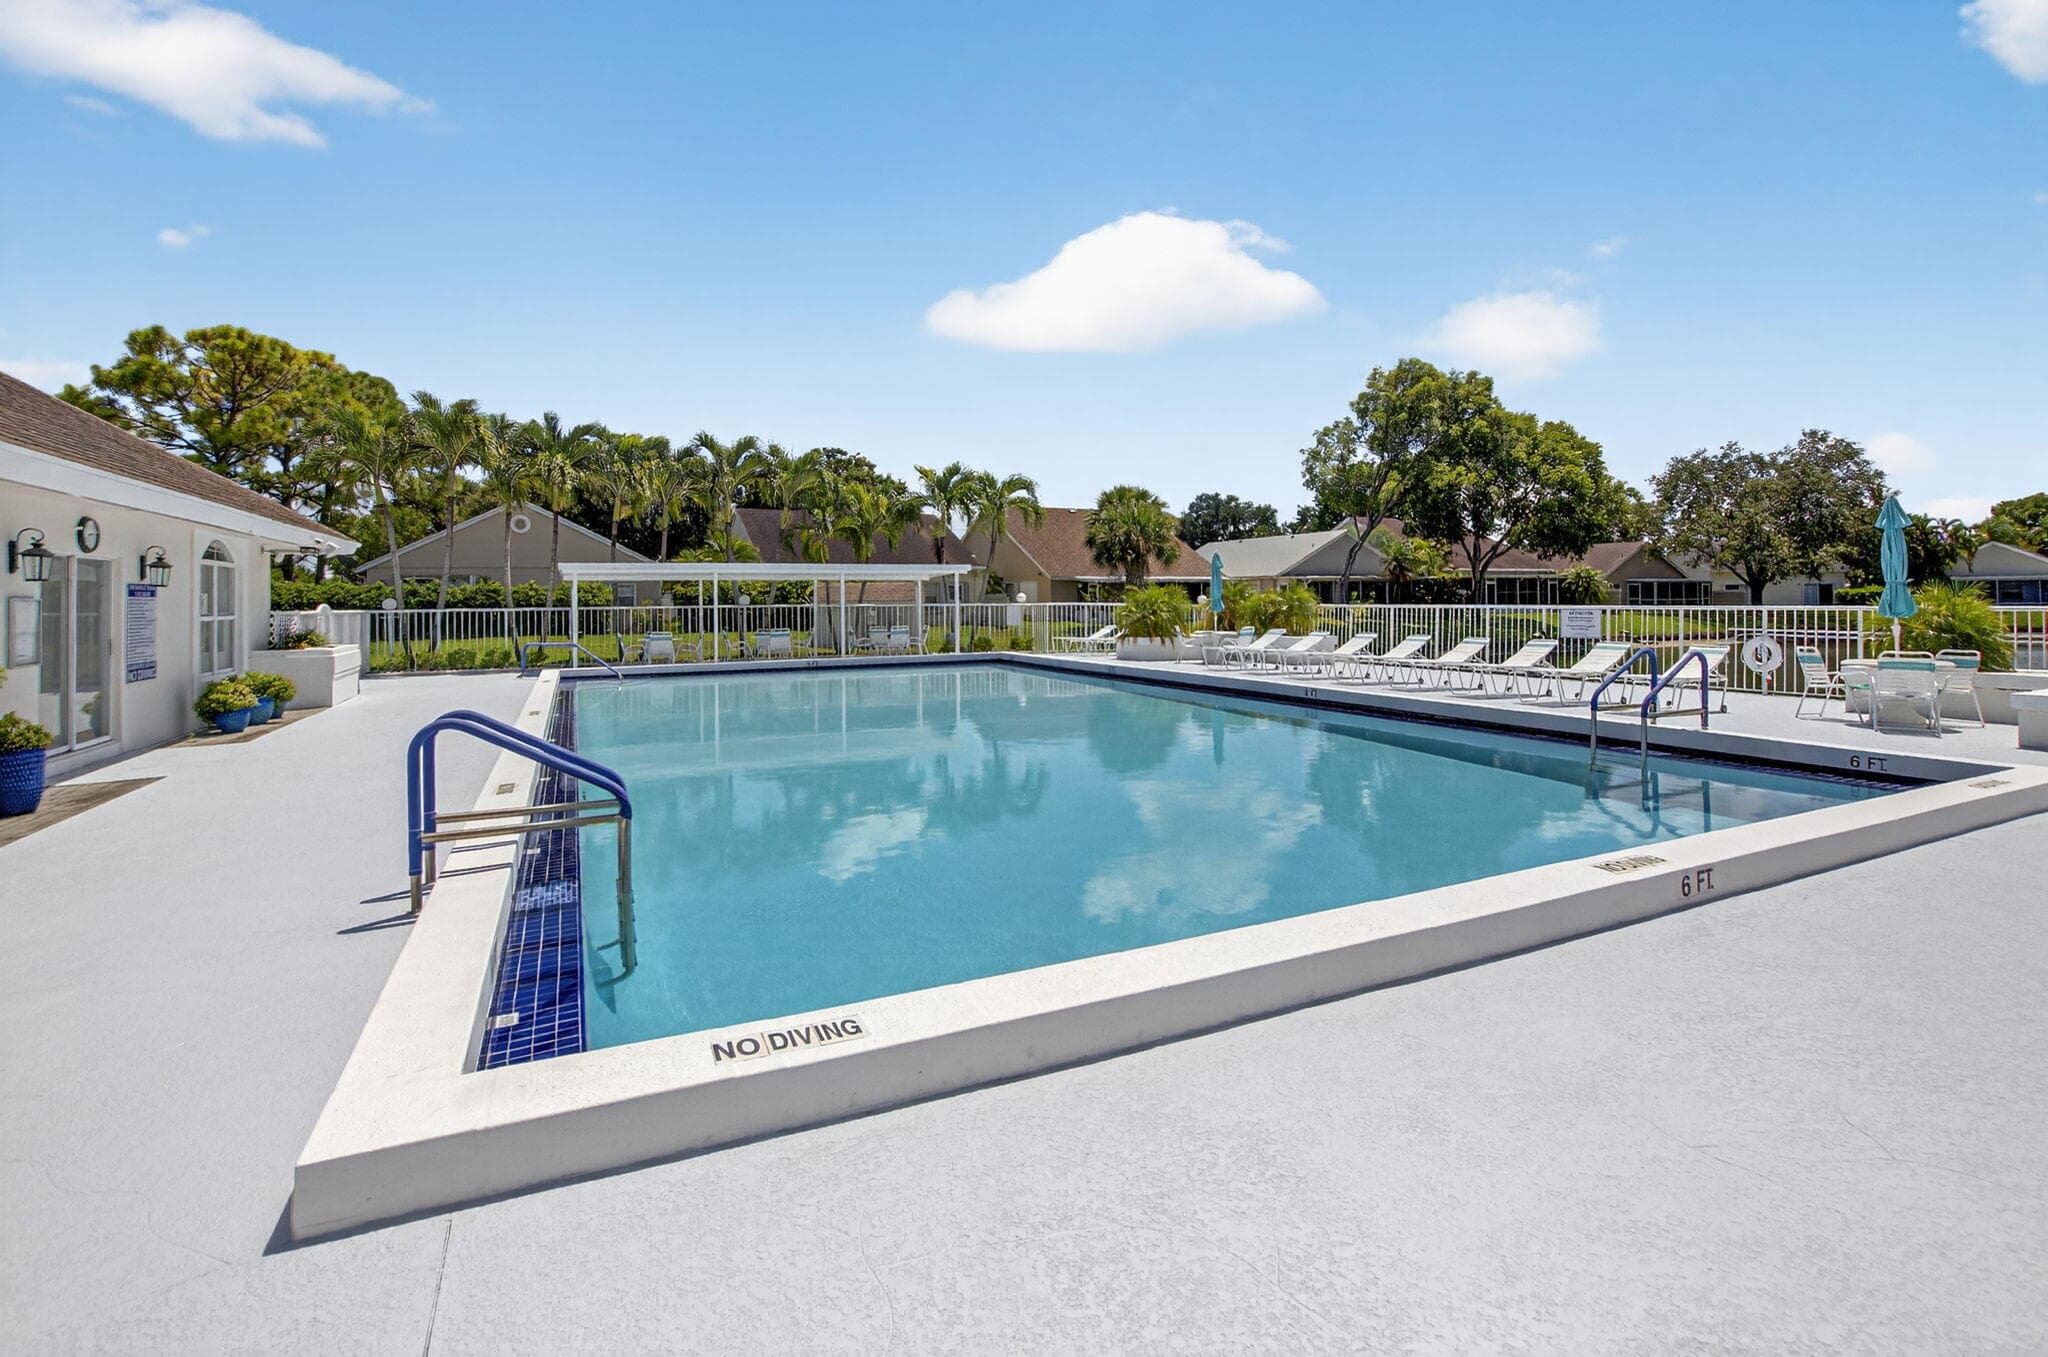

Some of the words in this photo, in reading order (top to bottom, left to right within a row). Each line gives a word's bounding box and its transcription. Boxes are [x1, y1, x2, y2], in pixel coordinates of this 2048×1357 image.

[1850, 755, 1860, 768] 6
[1681, 875, 1691, 897] 6
[712, 1038, 760, 1062] NO
[768, 1019, 863, 1051] DIVING
